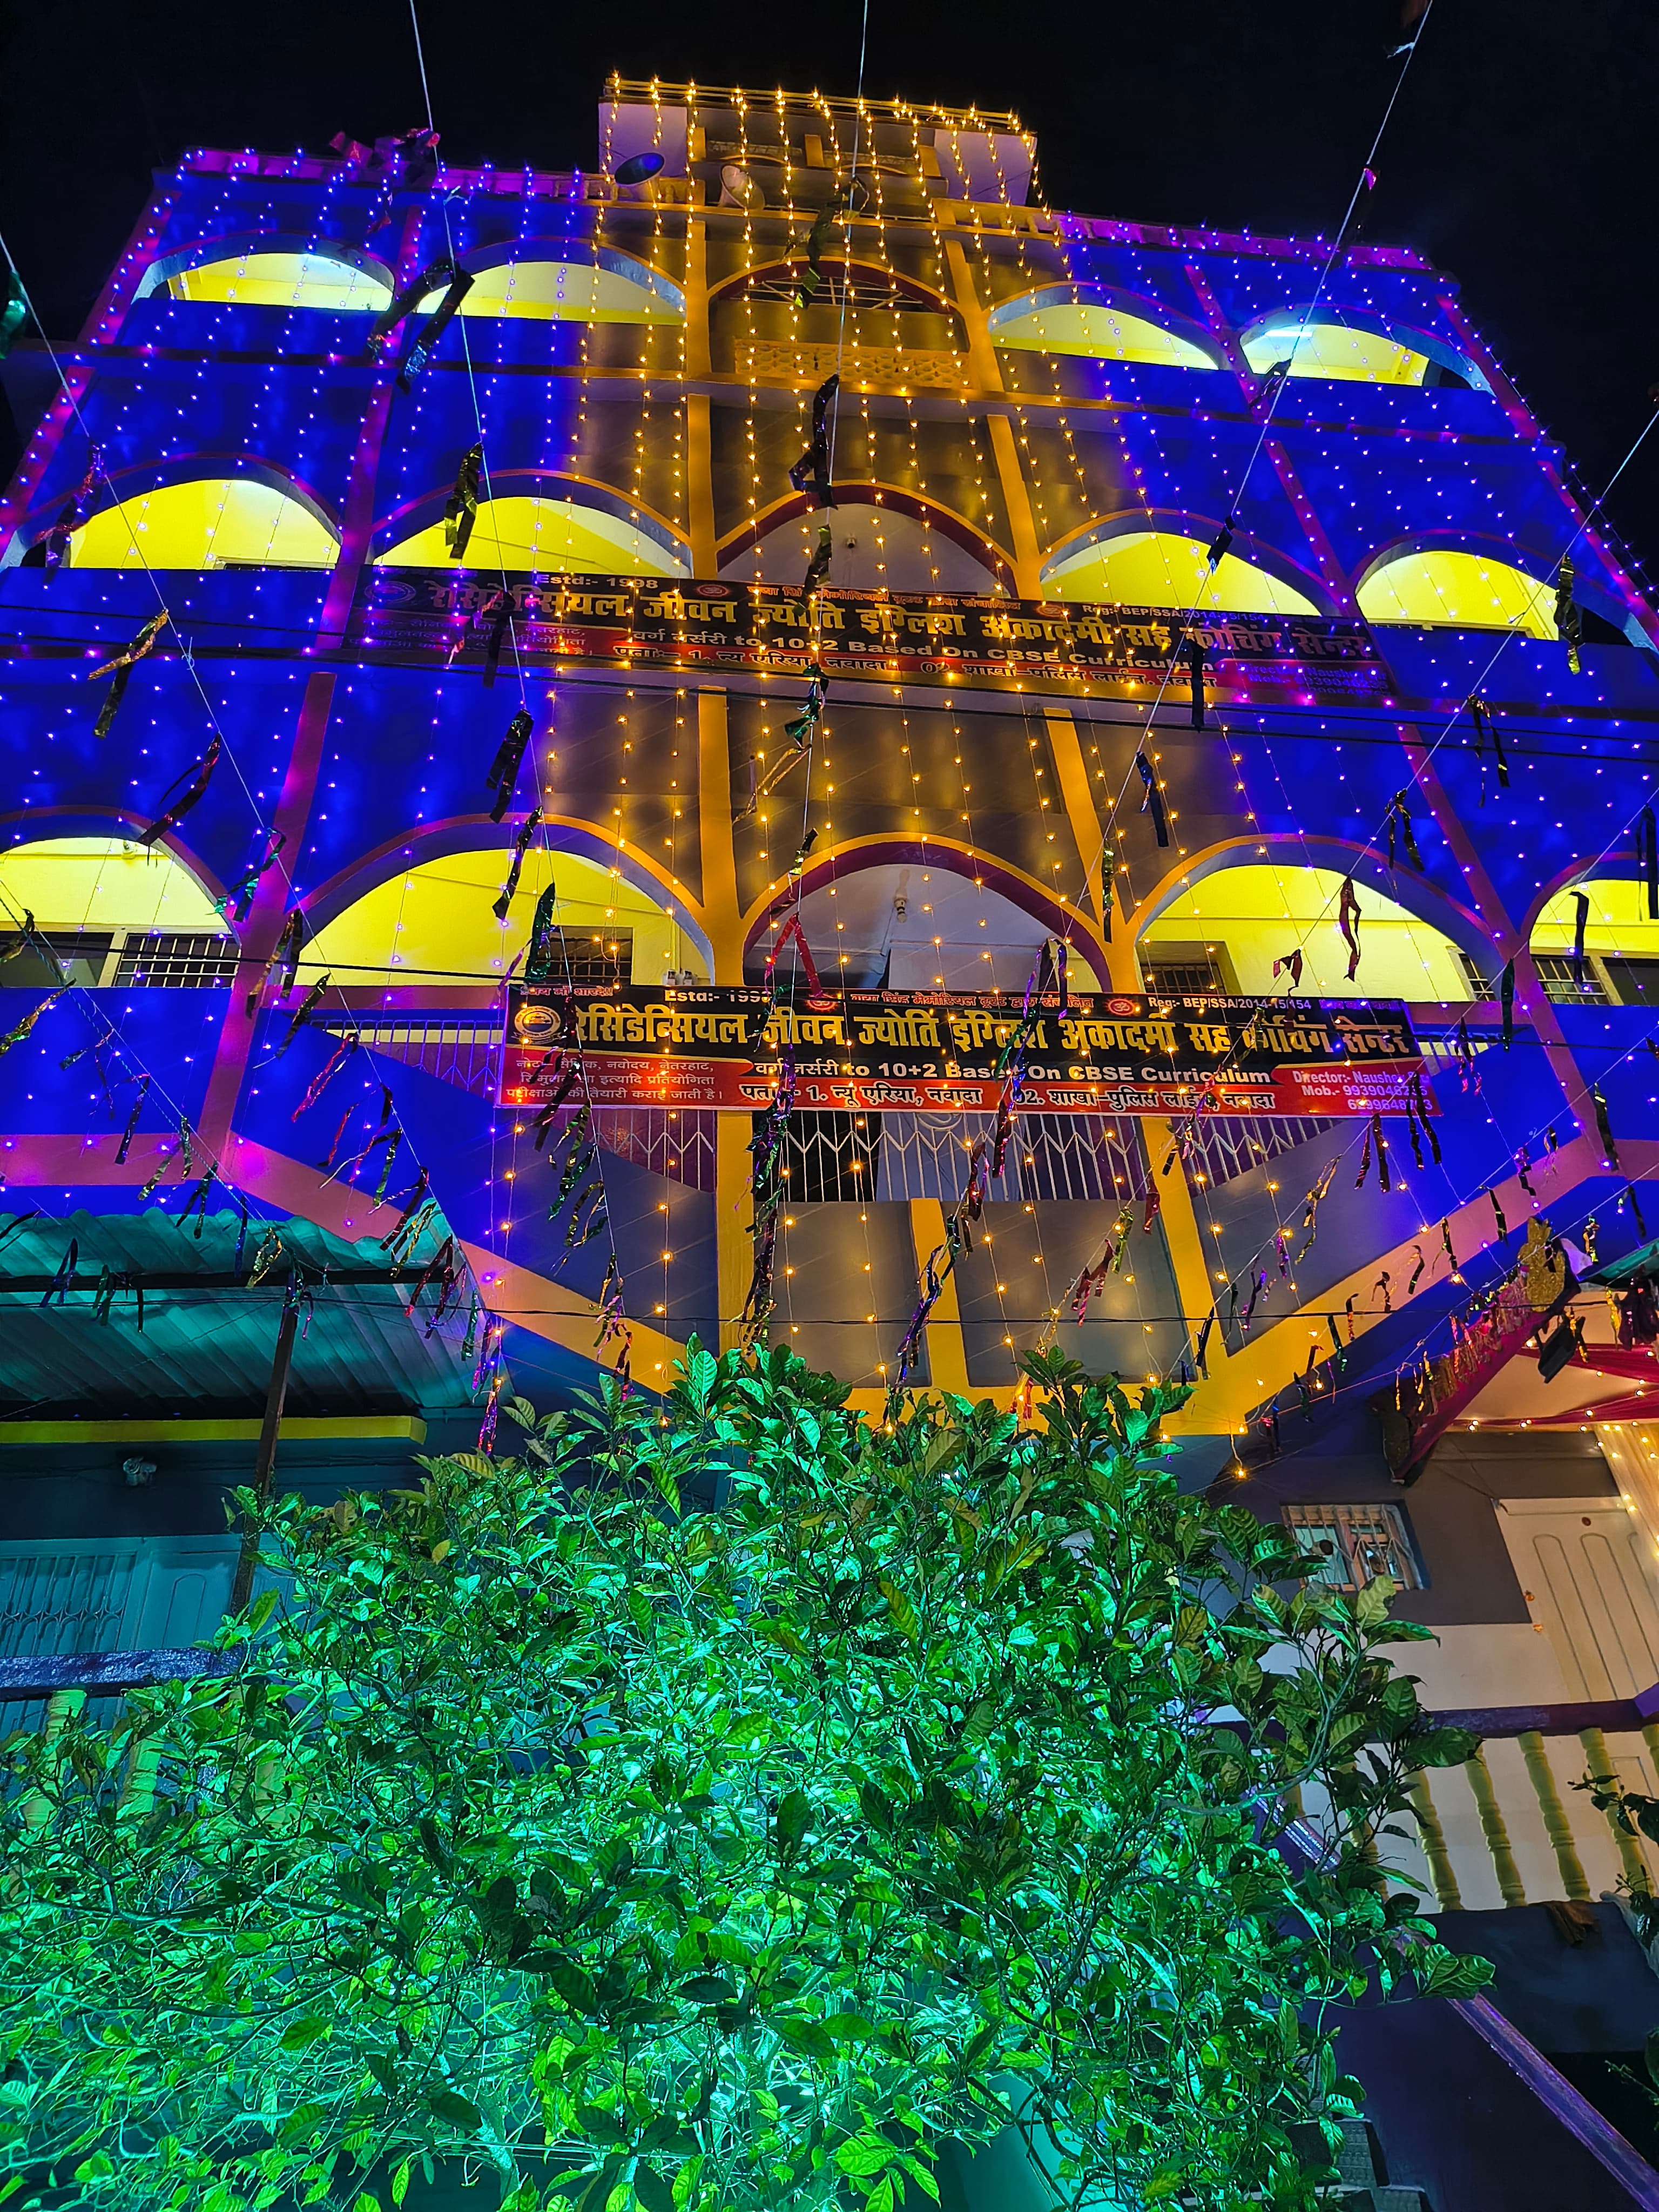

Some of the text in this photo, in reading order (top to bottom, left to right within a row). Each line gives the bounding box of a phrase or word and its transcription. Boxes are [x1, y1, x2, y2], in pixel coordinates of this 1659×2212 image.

[538, 574, 658, 589] Estd:- 1998
[782, 586, 805, 597] सिं
[640, 591, 738, 623] जीवन
[748, 598, 846, 629] ज्योति
[979, 615, 1114, 645] अकादमी
[1120, 624, 1171, 648] सह
[1179, 622, 1286, 653] कोचिंग
[633, 628, 665, 641] वर्ग
[734, 635, 762, 646] to
[772, 637, 839, 651] 10+2
[848, 640, 933, 656] Based
[942, 646, 978, 658] On
[988, 649, 1061, 663] CBSE
[911, 992, 976, 1006] मेमोरियल
[978, 996, 1007, 1009] ट्रस्ट
[1148, 997, 1181, 1009] Reg:-
[758, 1006, 844, 1047] जीवन
[854, 1008, 941, 1047] ज्योति
[1061, 1013, 1179, 1051] अकादमी
[1183, 1022, 1231, 1051] सह
[607, 1058, 654, 1071] नवोदय,
[658, 1059, 713, 1072] नेतरहाट,
[754, 1057, 785, 1075] वर्ग
[794, 1058, 839, 1076] नर्सरी
[846, 1062, 871, 1076] to
[879, 1062, 938, 1078] 10+2
[1028, 1065, 1061, 1080] On
[1068, 1065, 1135, 1081] CBSE
[1141, 1067, 1271, 1083] Curriculum
[599, 1074, 642, 1085] इत्यादि
[646, 1074, 714, 1086] प्रतियोगिता
[1292, 1070, 1351, 1084] Director:-
[568, 1088, 585, 1098] की
[589, 1088, 627, 1098] तैयारी
[670, 1090, 702, 1100] जाती
[830, 1084, 862, 1108] न्यू
[861, 1081, 922, 1106] एरिया,
[926, 1086, 983, 1104] नवादा
[1301, 1084, 1340, 1096] Mob.-
